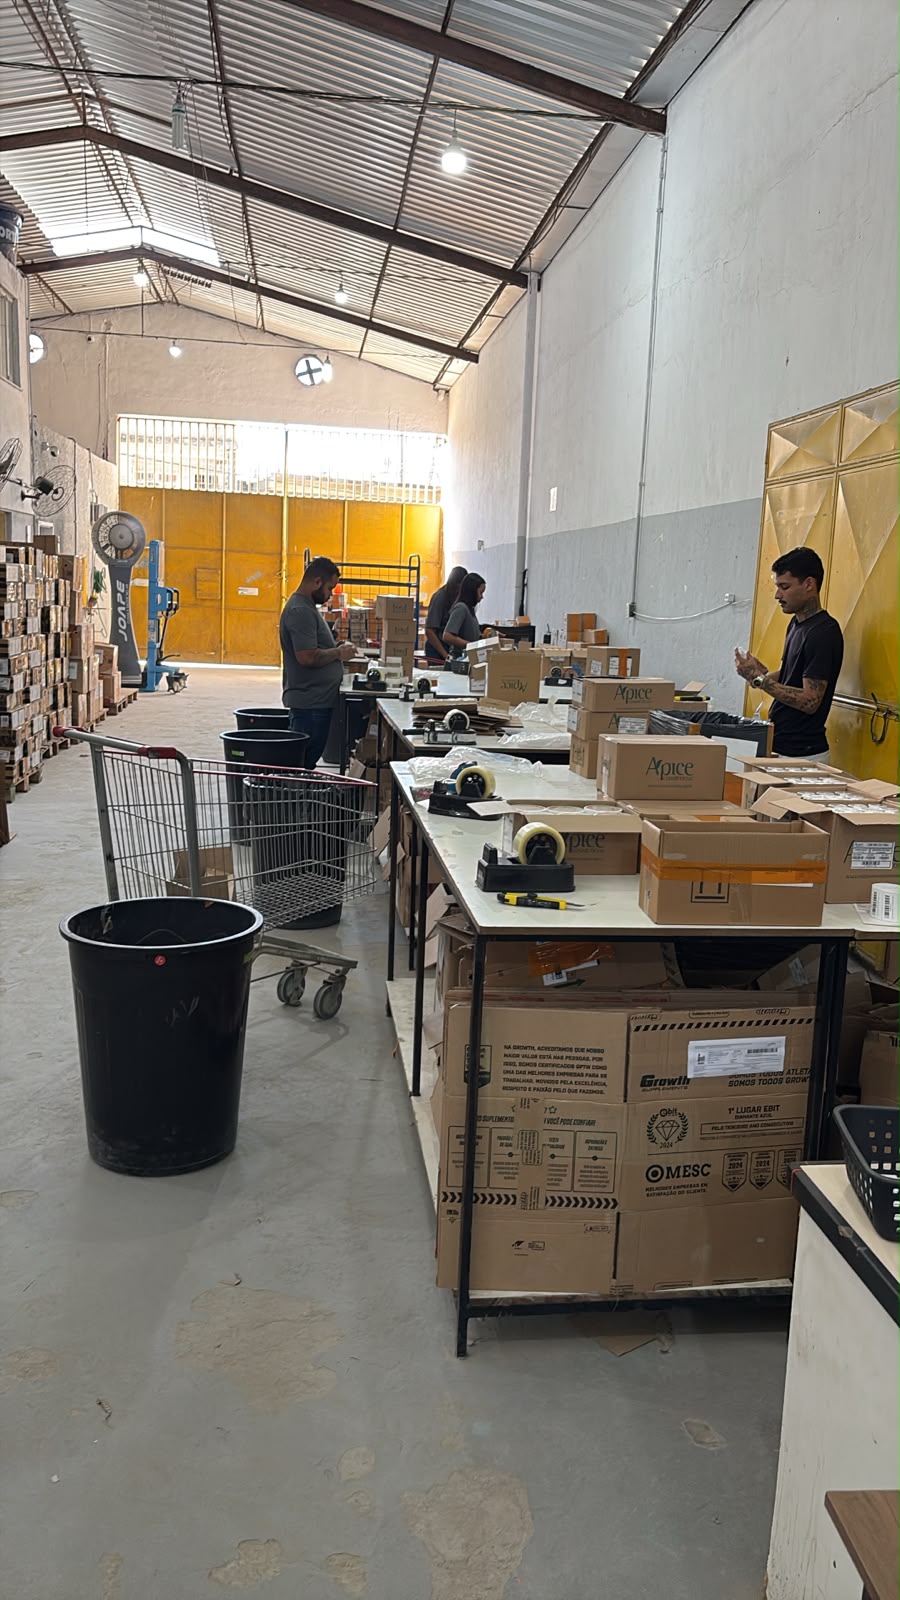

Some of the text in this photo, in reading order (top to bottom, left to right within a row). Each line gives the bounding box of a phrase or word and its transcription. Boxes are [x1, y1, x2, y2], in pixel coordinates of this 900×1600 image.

[116, 580, 128, 642] JOAPE
[565, 832, 605, 853] pice
[640, 1074, 690, 1087] Growth
[728, 1079, 755, 1087] SOMOS
[735, 1105, 761, 1114] LUGAR
